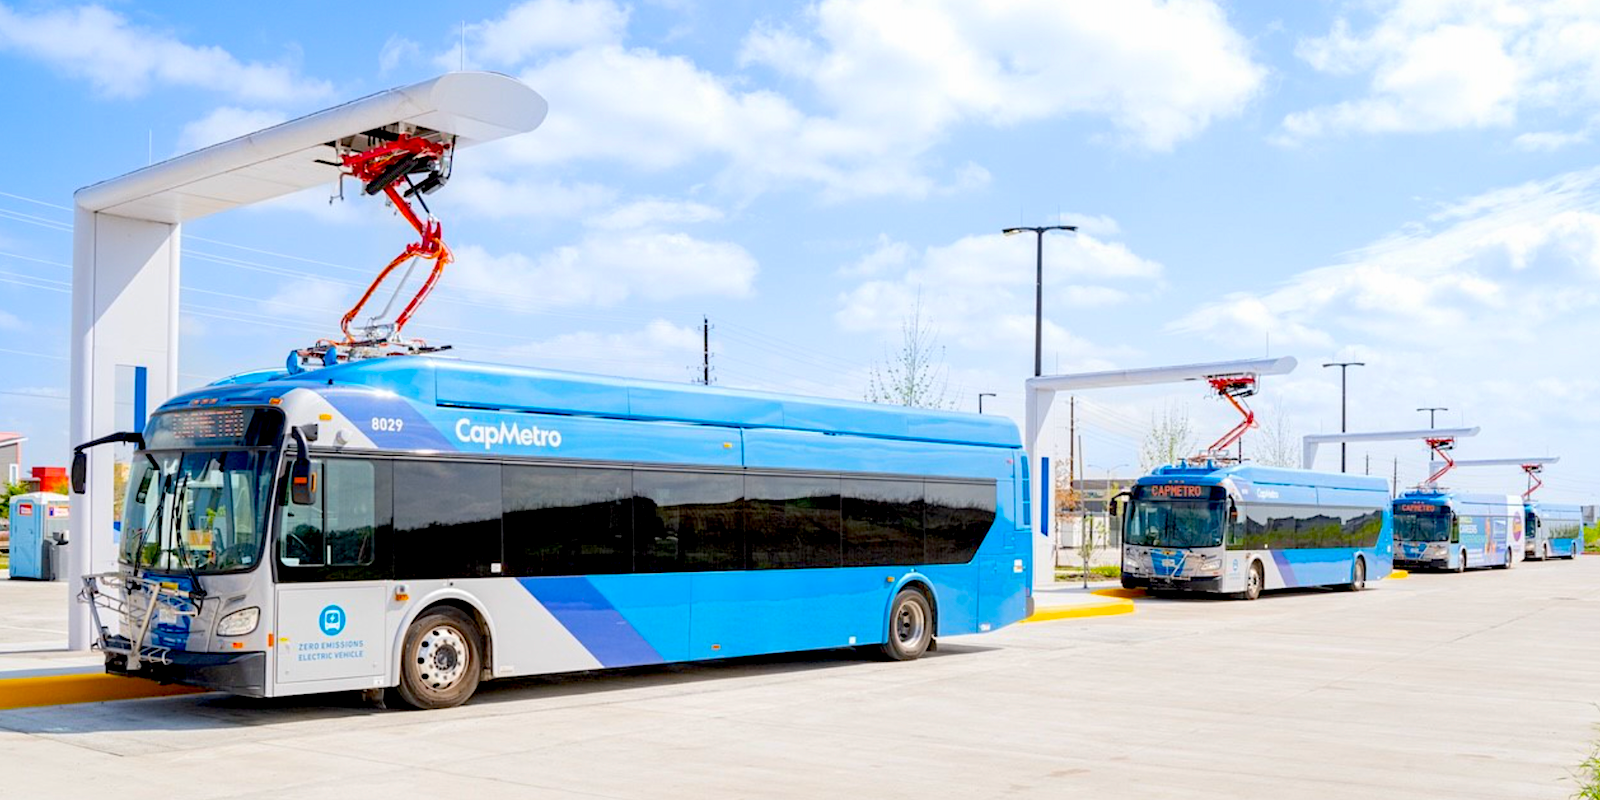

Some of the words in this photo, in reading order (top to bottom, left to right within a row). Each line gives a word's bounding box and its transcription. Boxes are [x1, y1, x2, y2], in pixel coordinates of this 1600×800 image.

[371, 417, 404, 432] 8029
[455, 418, 562, 449] CapMetro
[1151, 485, 1202, 497] CAPMETRO
[298, 642, 320, 651] ZERO
[321, 640, 364, 649] EMISSIONS
[298, 652, 333, 661] ELECTRIC
[334, 650, 364, 659] VEHICLE
